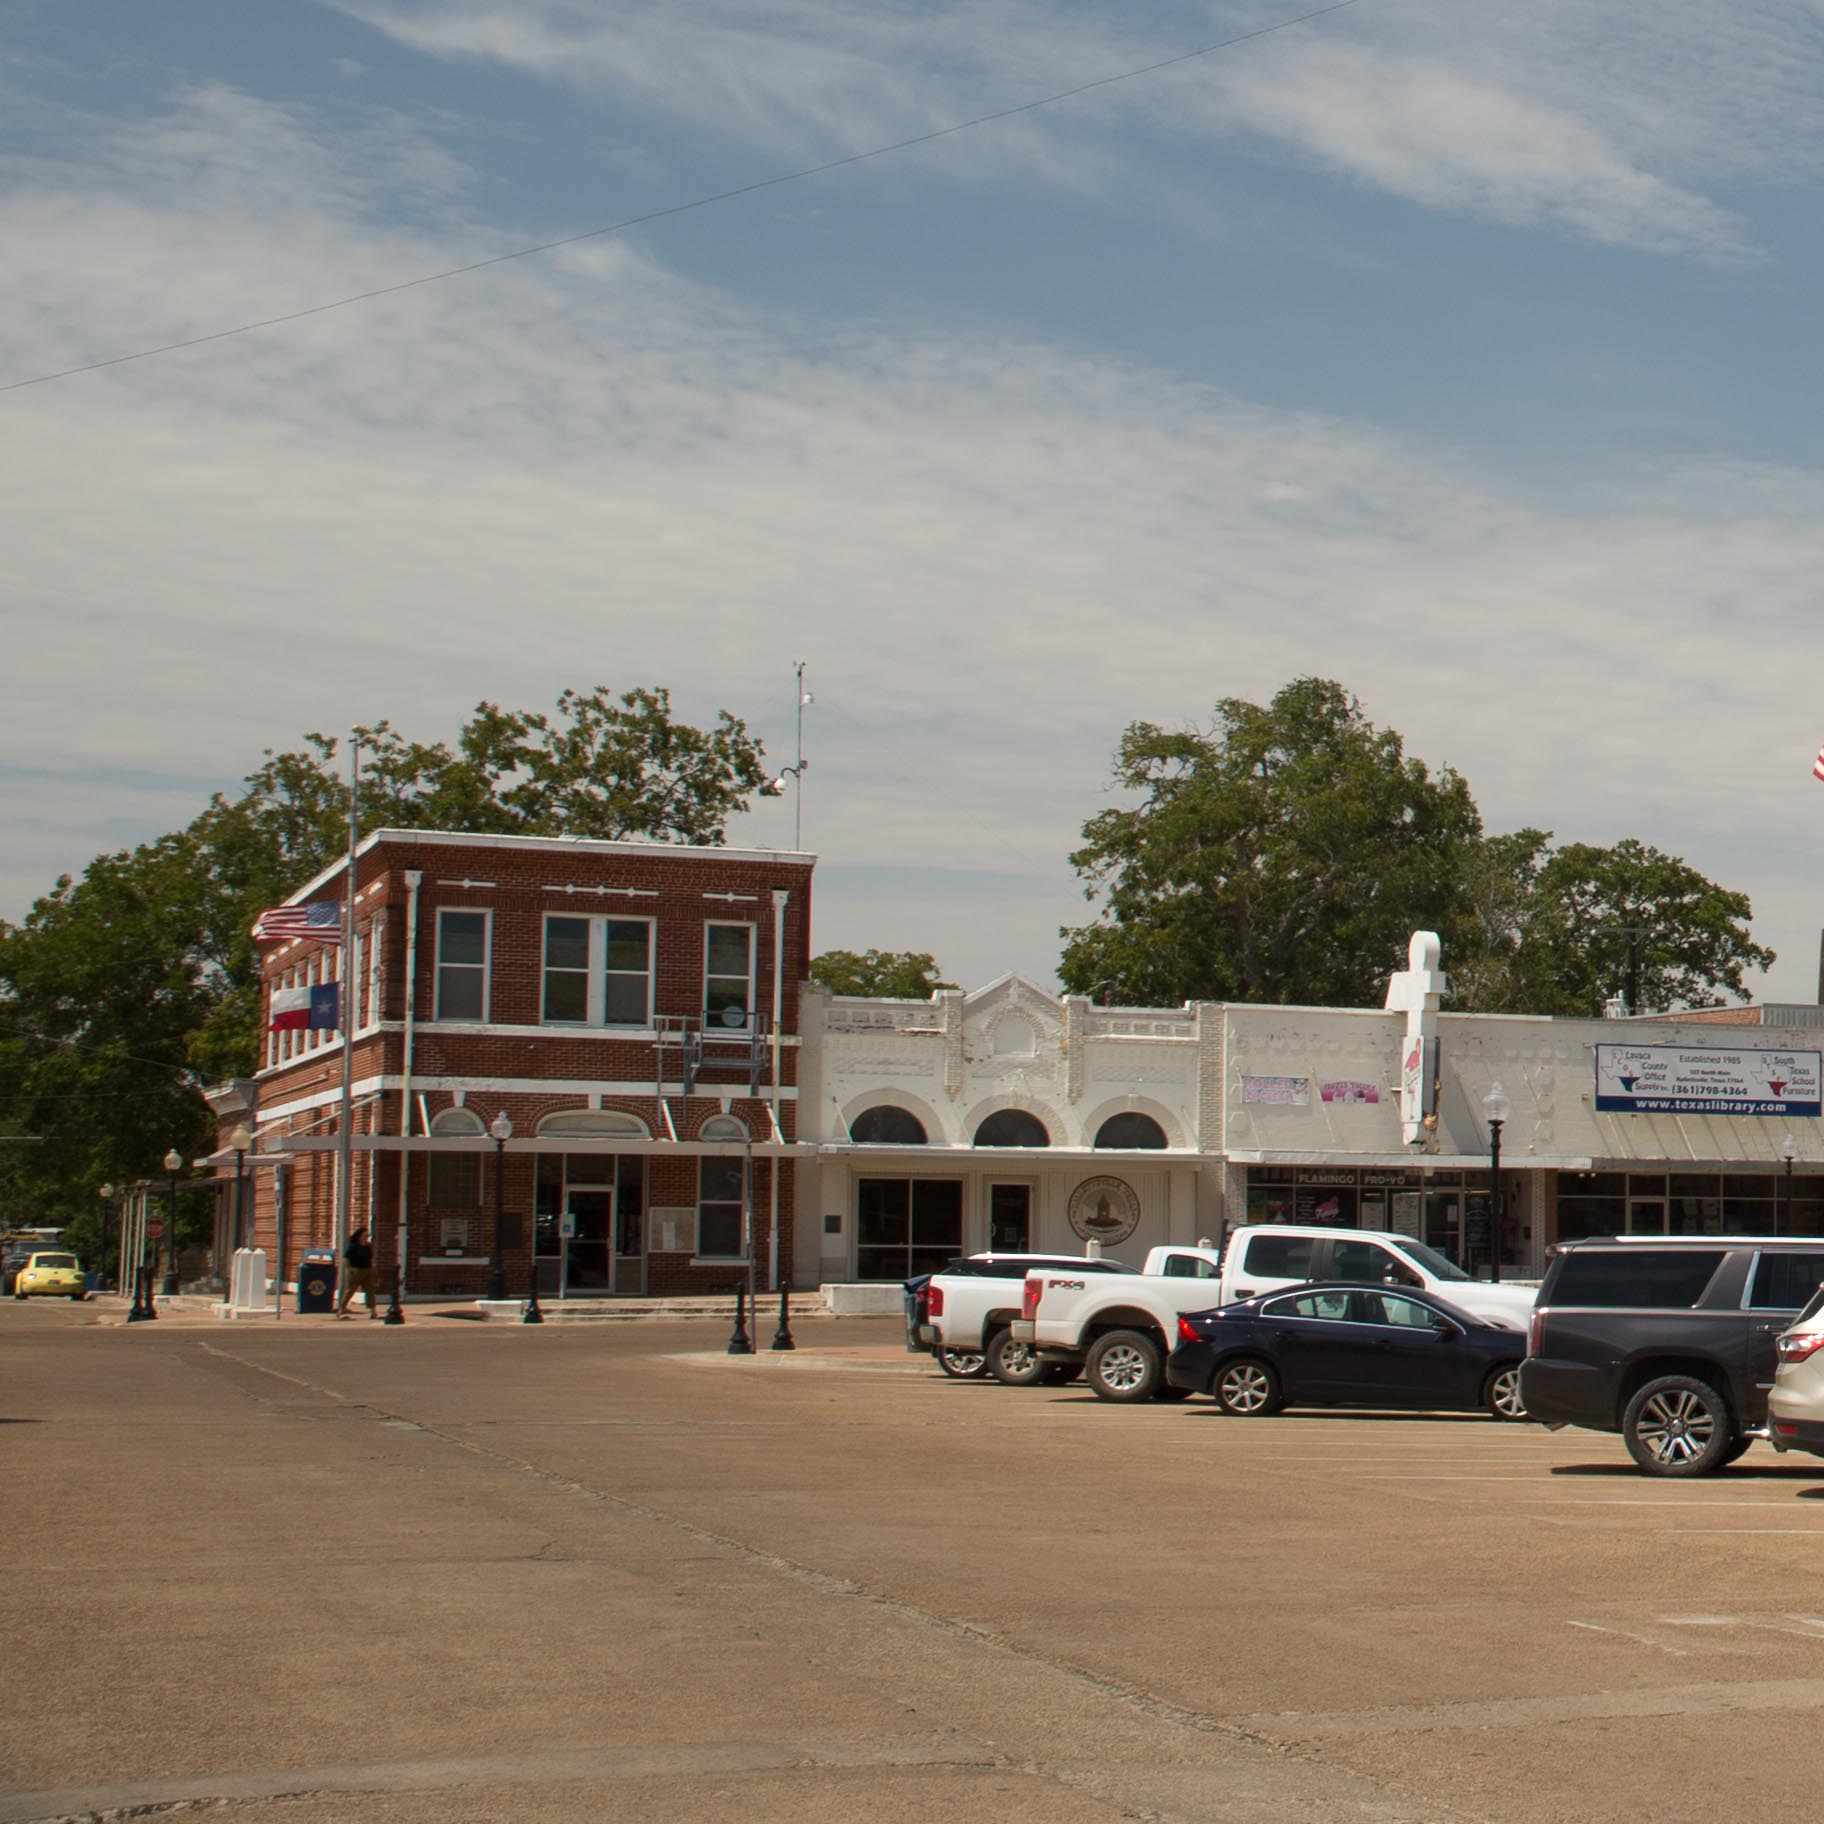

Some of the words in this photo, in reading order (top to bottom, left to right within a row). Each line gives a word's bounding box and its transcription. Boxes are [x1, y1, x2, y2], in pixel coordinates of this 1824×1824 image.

[1625, 1051, 1651, 1060] Lavaca
[1679, 1054, 1721, 1065] Established
[1722, 1056, 1742, 1065] 1985
[1774, 1056, 1795, 1065] South
[1642, 1062, 1668, 1071] County
[1790, 1066, 1810, 1075] Texas
[1644, 1071, 1666, 1081] Office
[1792, 1076, 1815, 1085] School
[1783, 1087, 1816, 1096] Furniture
[1636, 1099, 1787, 1113] www.texaslibrary.com
[1299, 1174, 1355, 1184] FLAMINGO
[1048, 1279, 1085, 1290] FX4
